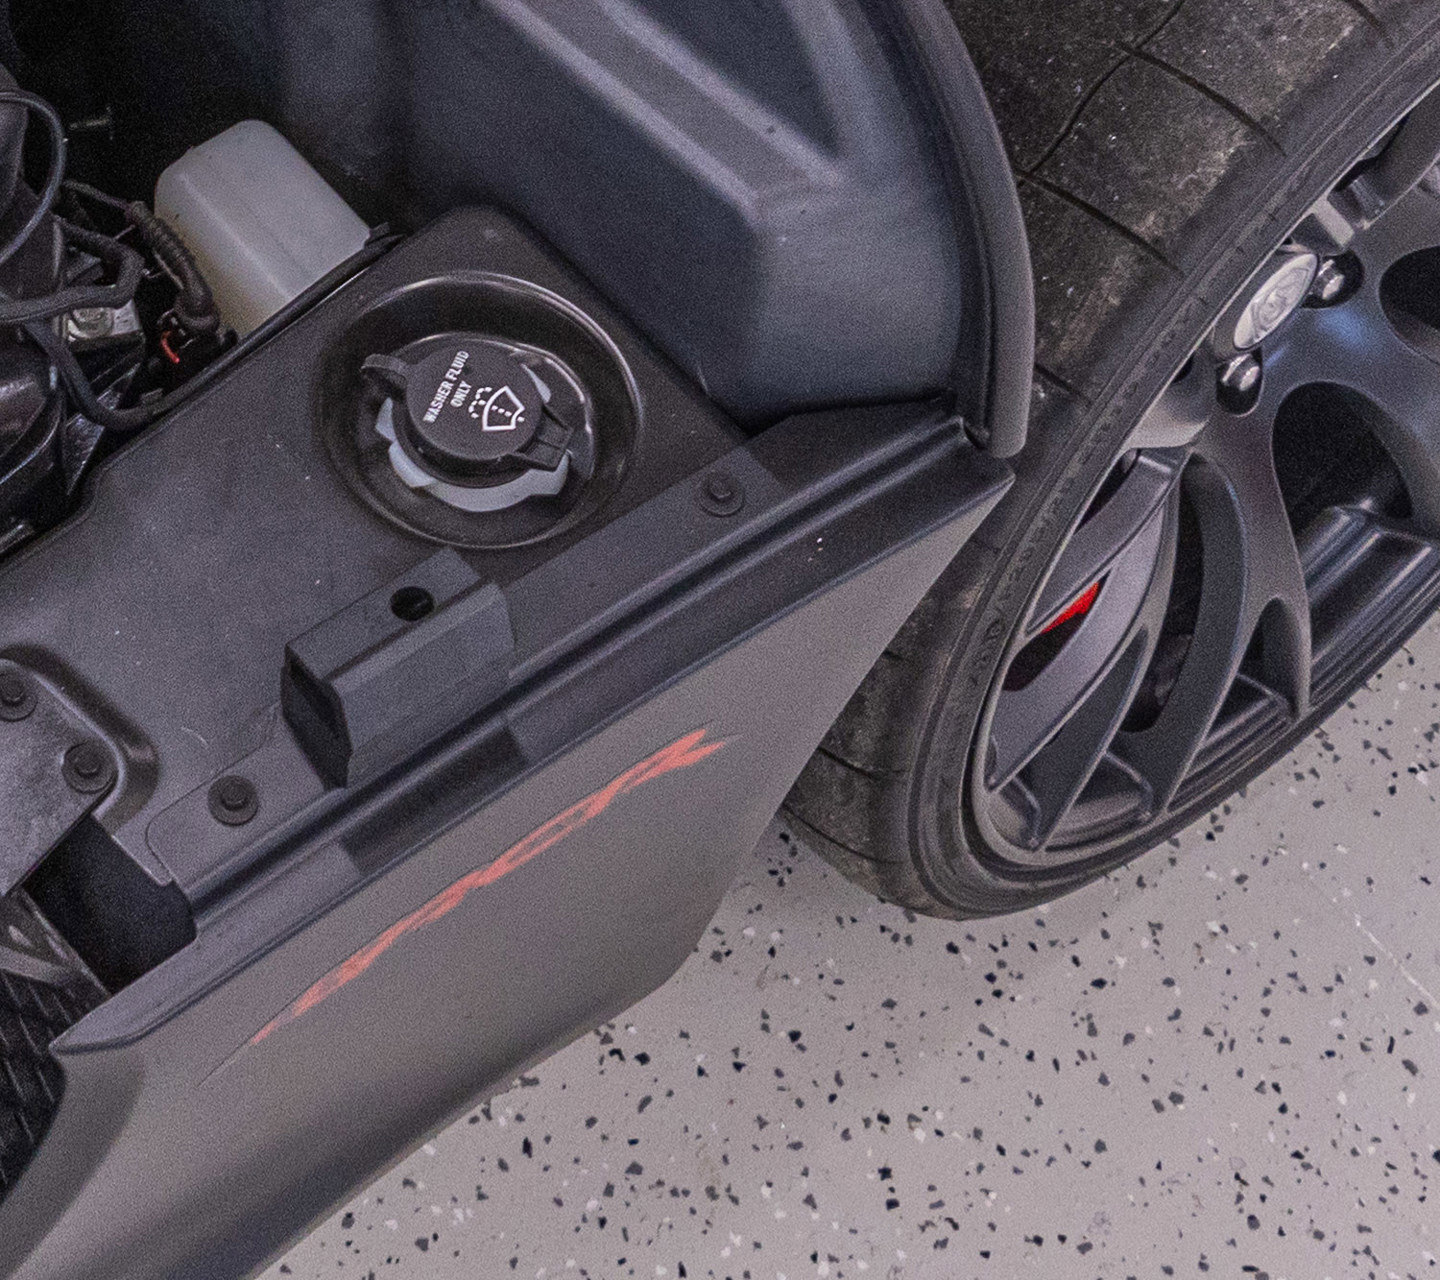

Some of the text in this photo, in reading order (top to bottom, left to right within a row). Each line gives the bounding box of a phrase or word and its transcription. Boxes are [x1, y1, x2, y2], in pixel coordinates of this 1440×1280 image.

[423, 350, 470, 423] WASHER FLUID
[450, 380, 472, 408] ONLY
